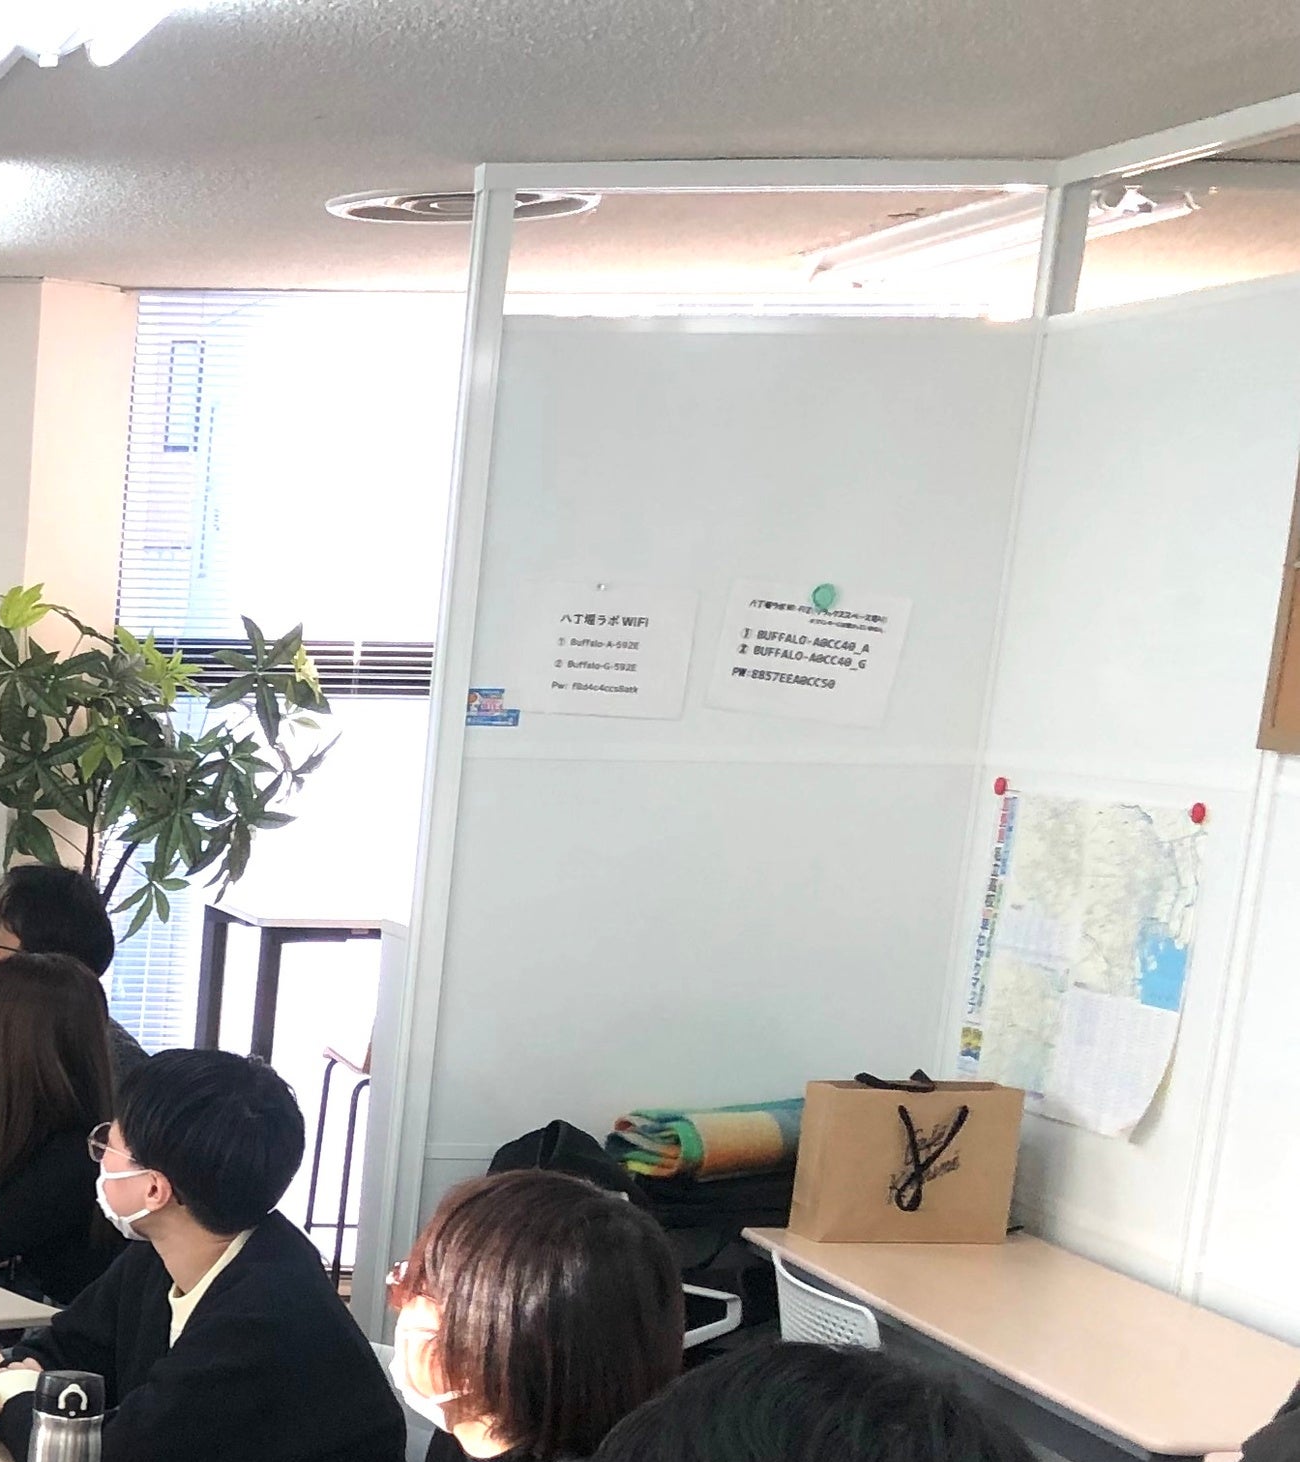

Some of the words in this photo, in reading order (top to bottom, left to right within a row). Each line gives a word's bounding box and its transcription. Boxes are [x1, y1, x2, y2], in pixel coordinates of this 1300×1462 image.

[560, 613, 620, 626] 八丁堀ラボ
